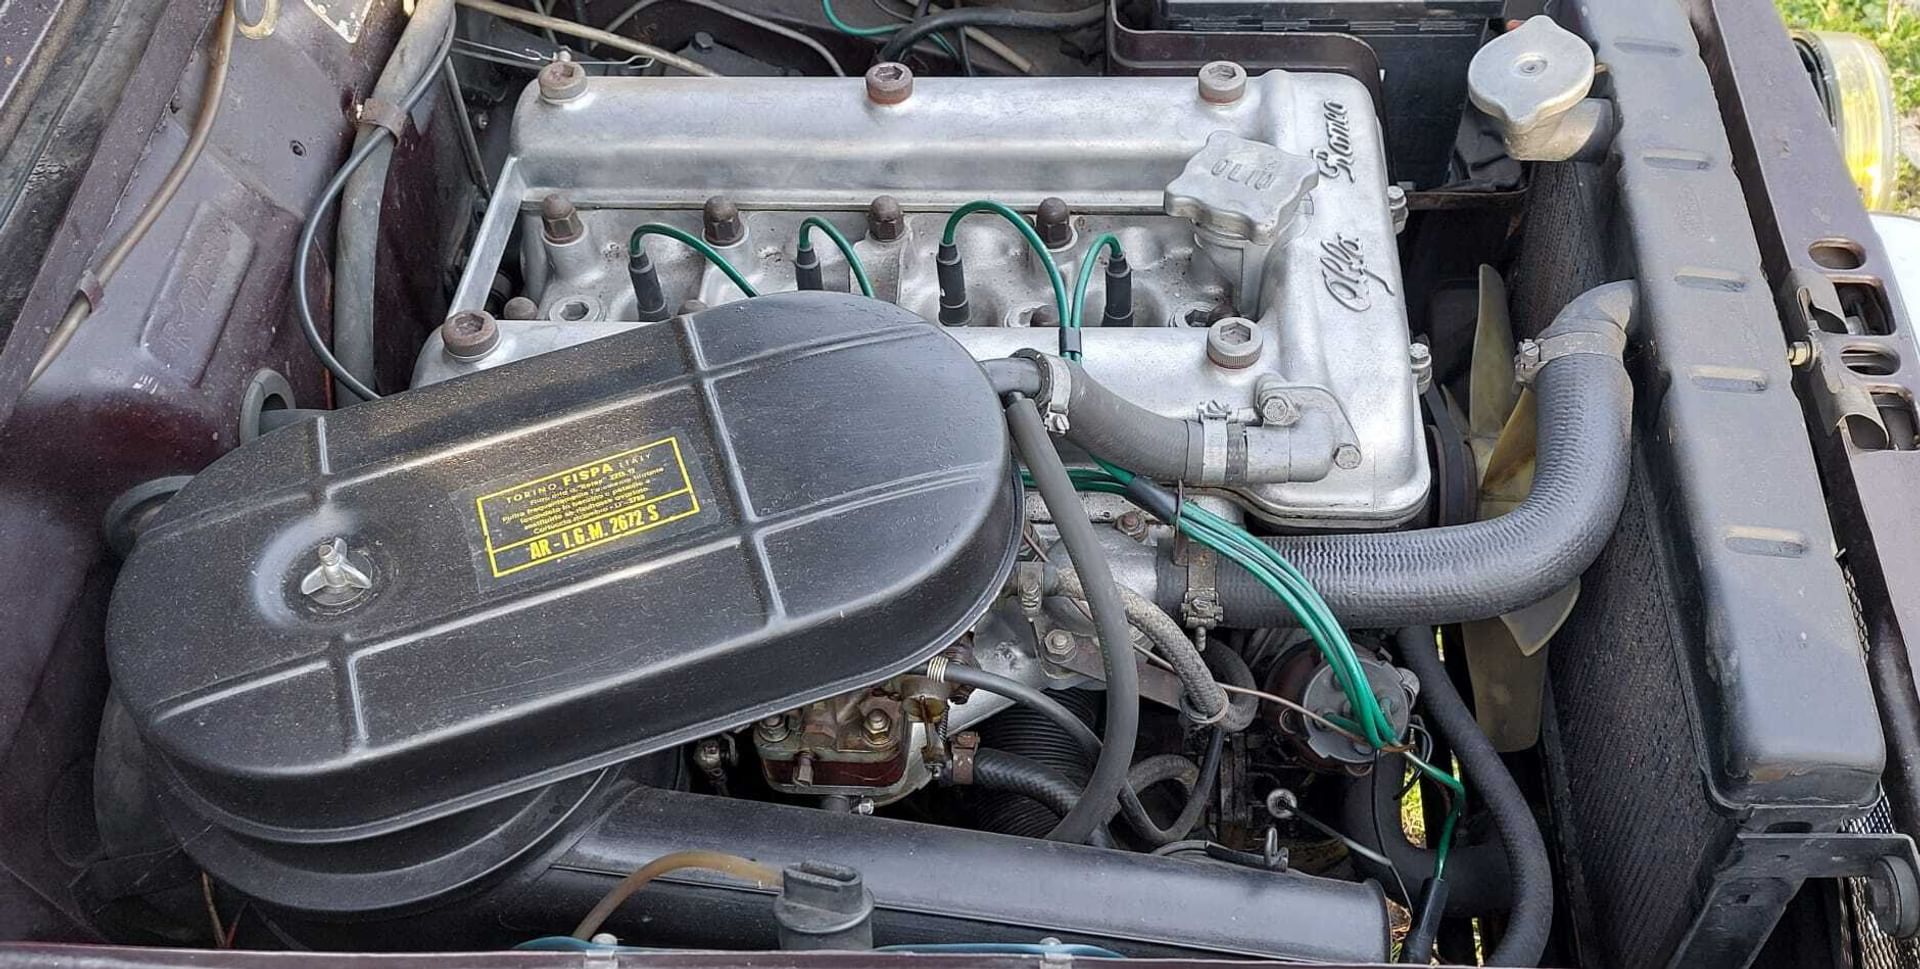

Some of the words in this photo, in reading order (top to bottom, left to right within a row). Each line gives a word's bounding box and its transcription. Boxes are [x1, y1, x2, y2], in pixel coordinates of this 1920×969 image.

[1311, 99, 1355, 183] Romeo
[1211, 158, 1276, 191] OLIO
[505, 482, 557, 504] TORINO
[561, 462, 613, 486] FISPA
[617, 452, 652, 468] ITALY
[527, 537, 552, 560] AR
[560, 519, 609, 550] I.G.M.
[608, 507, 645, 534] 2672
[645, 502, 660, 522] S
